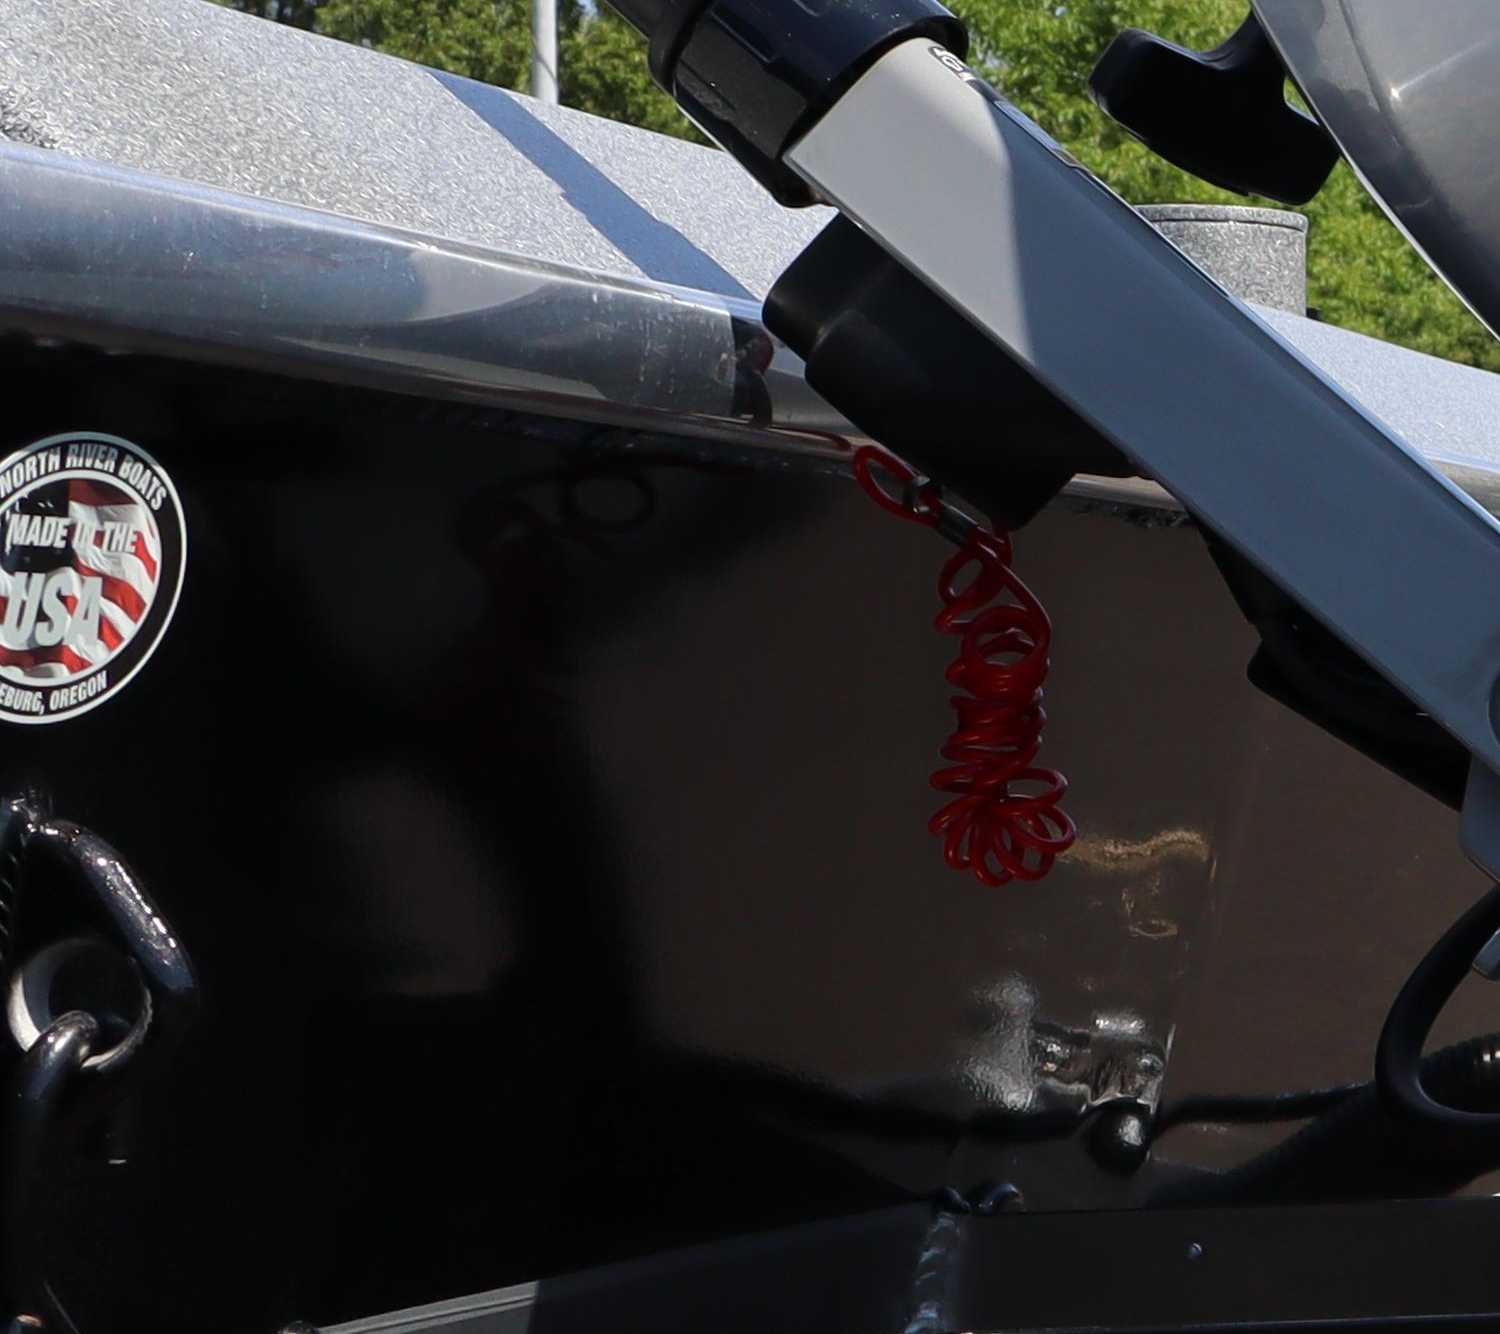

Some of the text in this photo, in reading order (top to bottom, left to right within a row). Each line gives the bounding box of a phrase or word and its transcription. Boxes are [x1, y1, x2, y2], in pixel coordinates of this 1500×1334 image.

[0, 444, 167, 510] NORTH RIVER BOATS
[8, 514, 70, 548] MADE
[102, 522, 137, 552] THE
[2, 572, 102, 647] USA
[49, 670, 107, 710] OREGON
